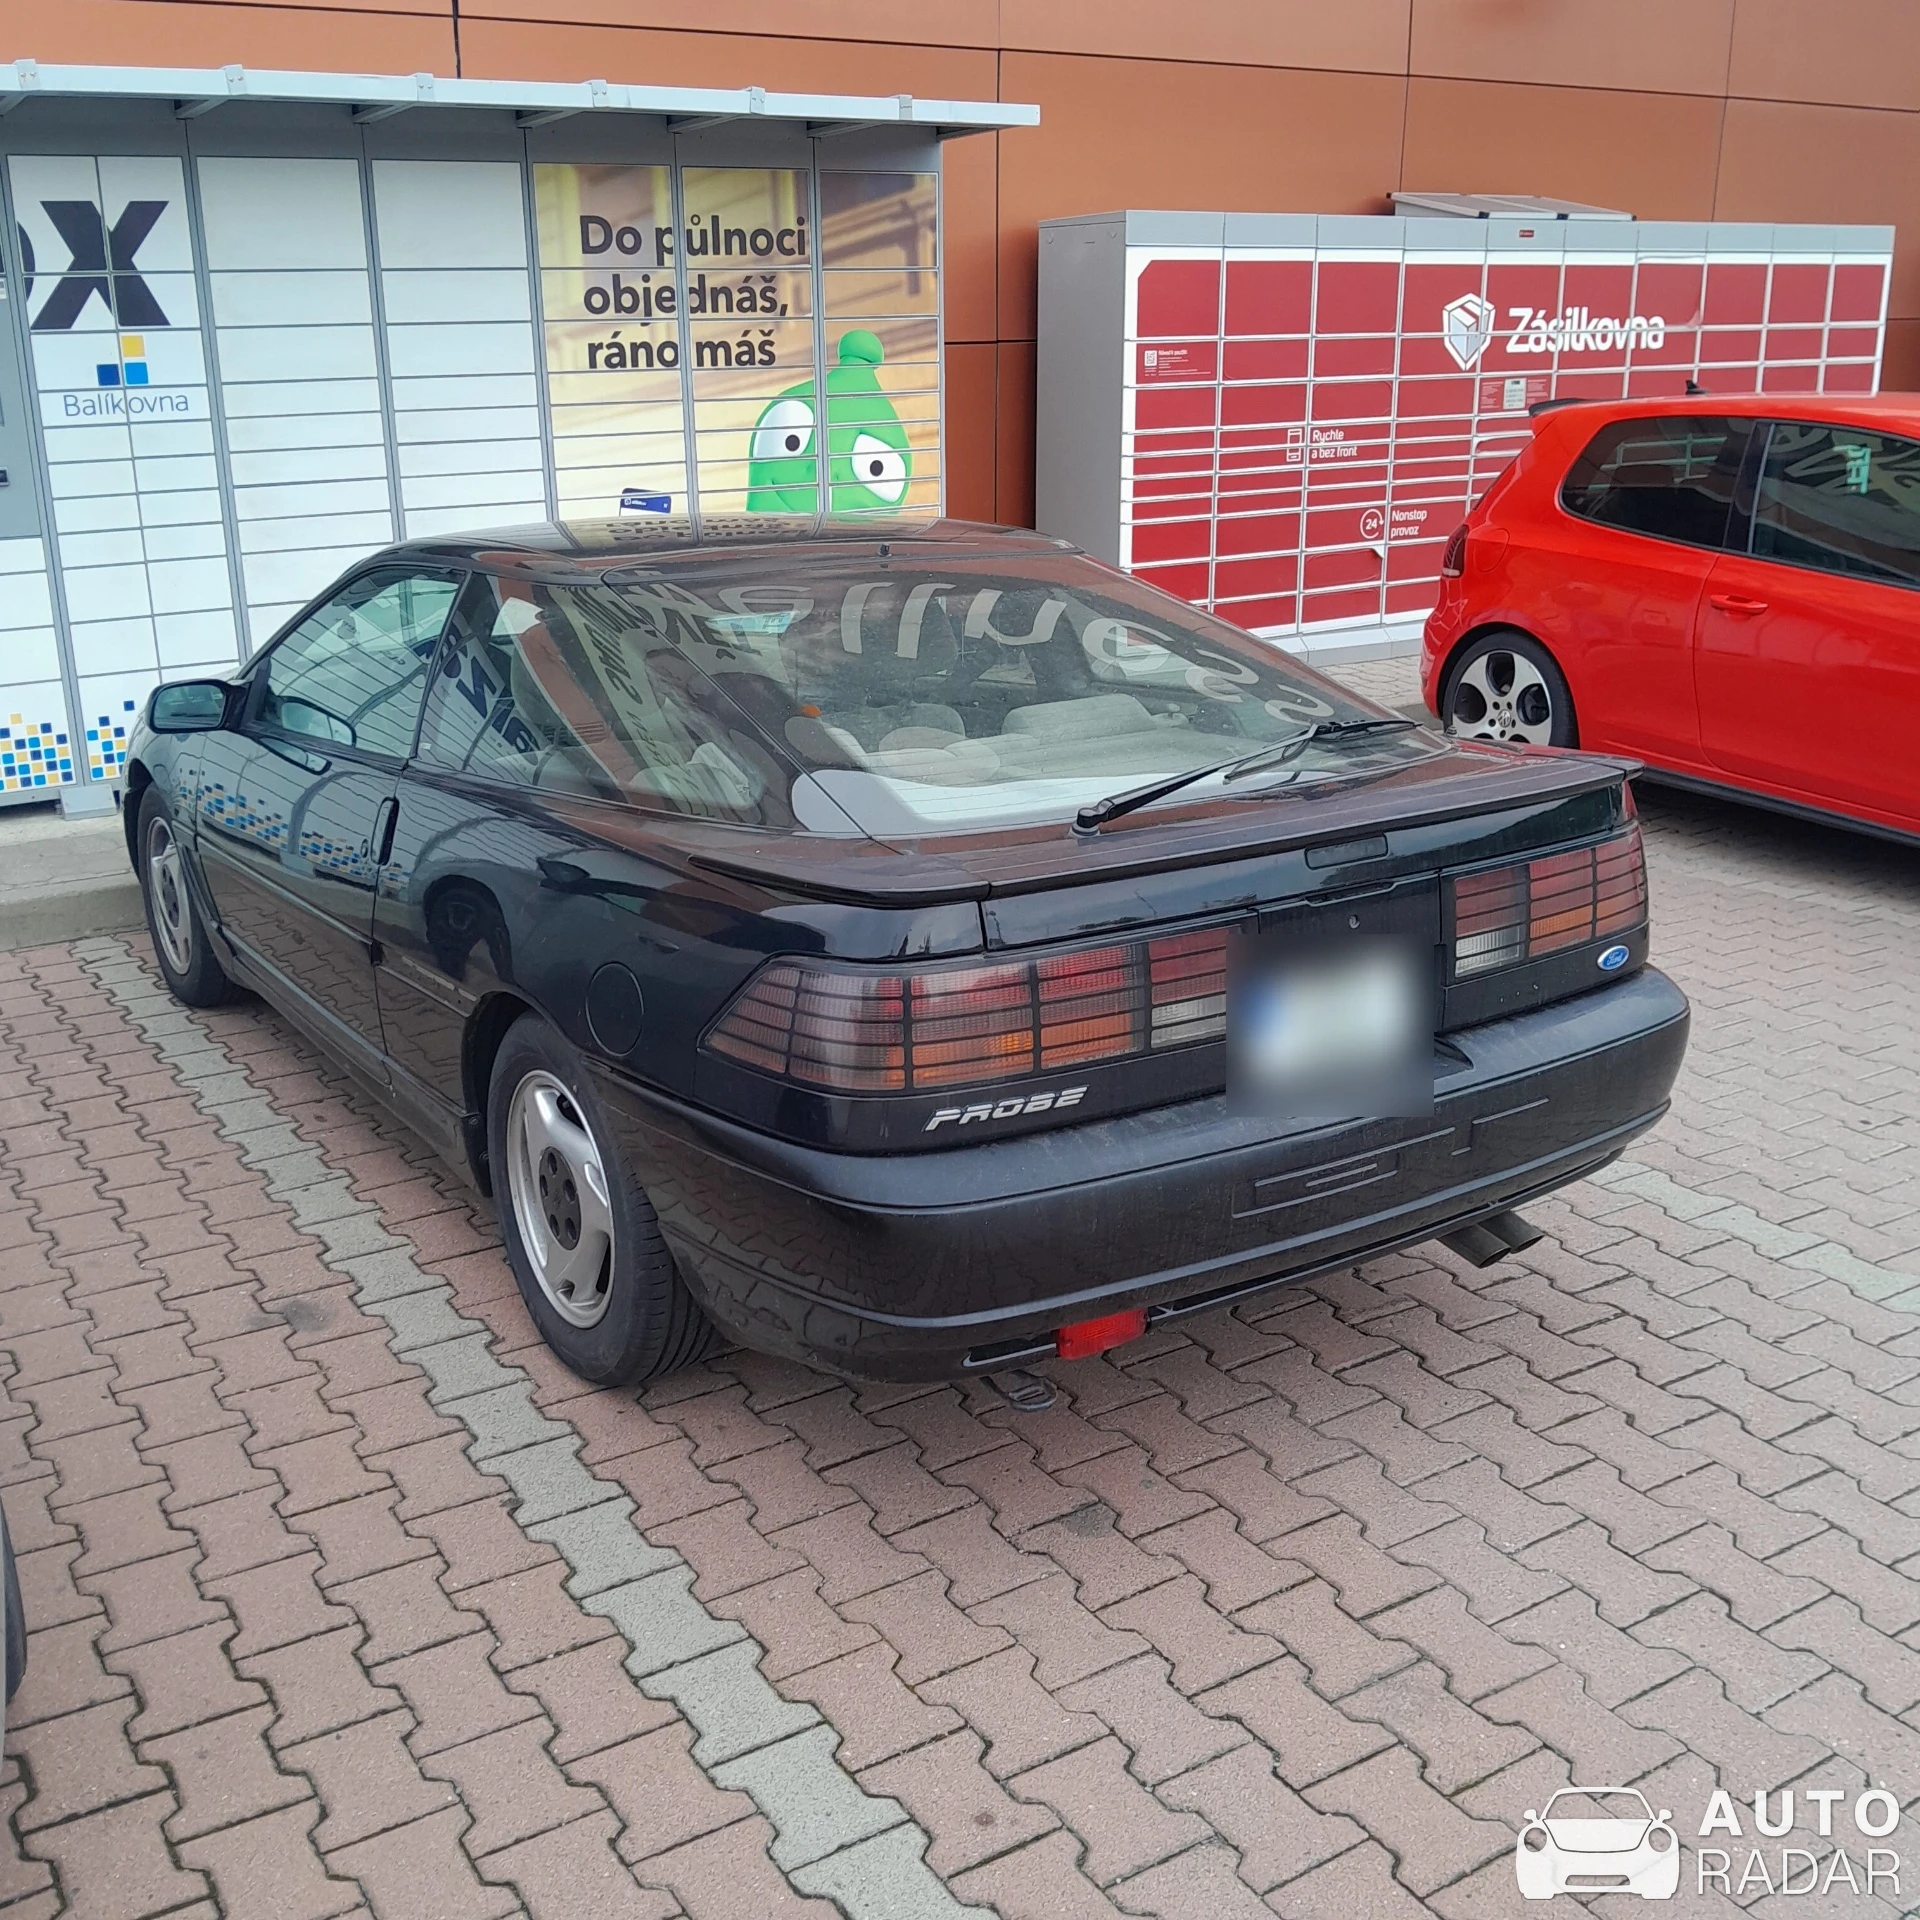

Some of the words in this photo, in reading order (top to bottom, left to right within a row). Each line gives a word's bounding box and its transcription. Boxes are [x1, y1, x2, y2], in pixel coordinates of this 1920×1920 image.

[580, 215, 642, 255] Do
[655, 213, 807, 266] půlnoci
[583, 273, 789, 326] objednáš,
[1506, 306, 1666, 354] Zásilkovna
[587, 330, 680, 370] ráno
[695, 328, 777, 368] máš
[63, 391, 190, 418] Balíkovna
[1312, 429, 1345, 444] Rychle
[1319, 447, 1336, 459] bez
[1337, 446, 1358, 458] front
[1365, 517, 1378, 531] 24
[1391, 509, 1428, 522] Nonstop
[1390, 525, 1419, 539] provoz
[922, 1085, 1089, 1132] PROBE
